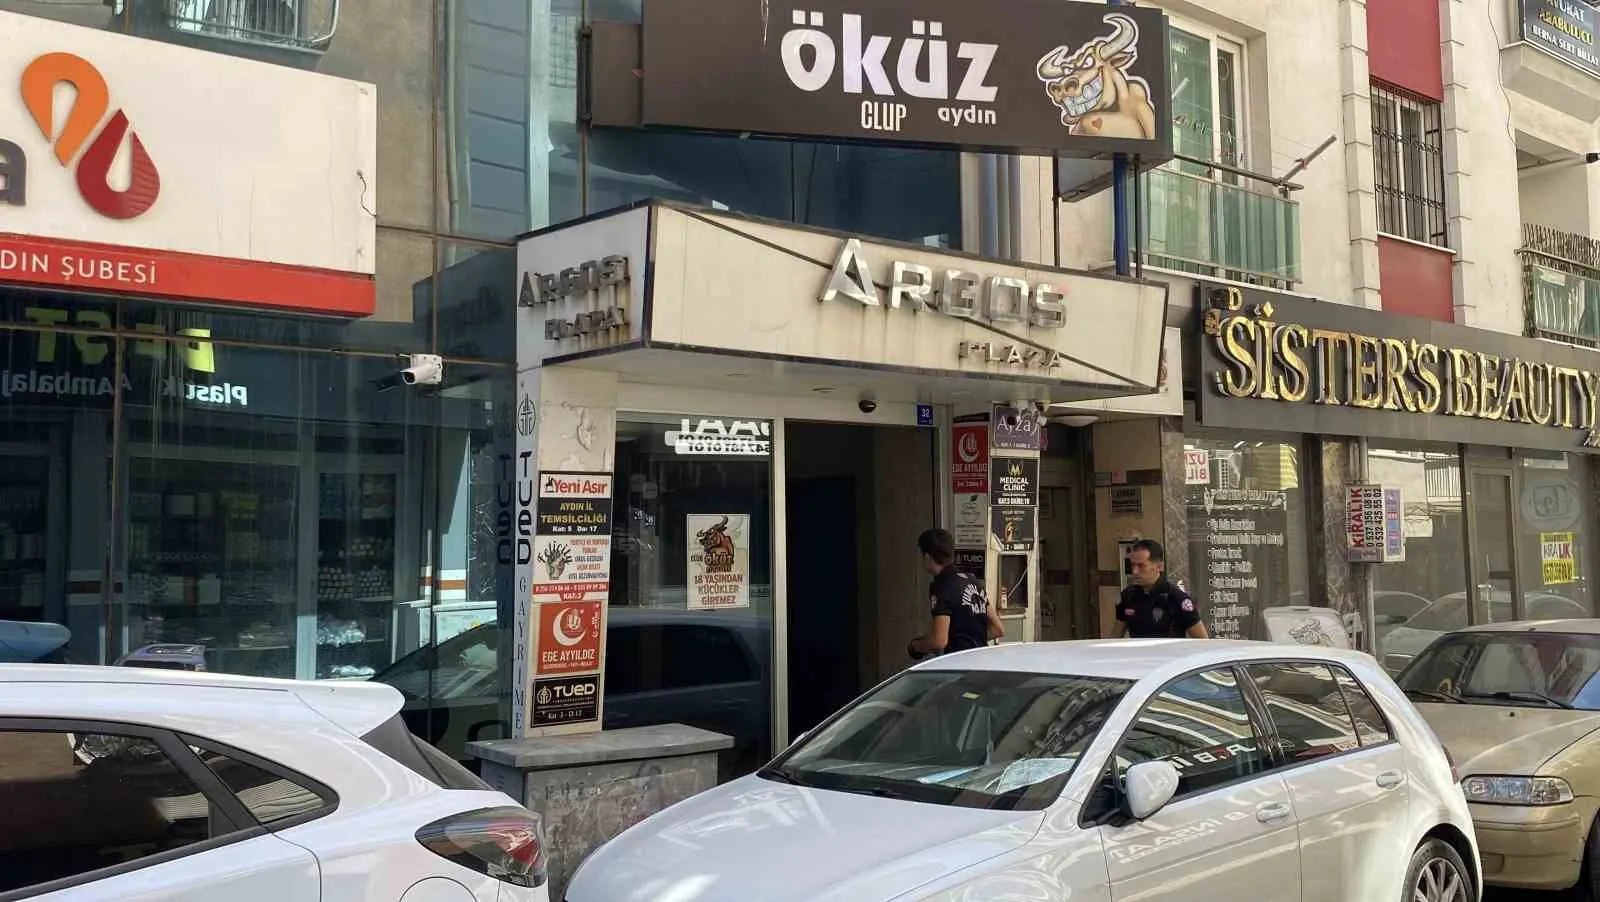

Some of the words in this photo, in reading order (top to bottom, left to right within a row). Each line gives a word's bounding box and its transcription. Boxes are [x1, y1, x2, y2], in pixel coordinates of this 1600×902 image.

[780, 9, 999, 103] öküz
[861, 100, 907, 132] CLUP
[937, 105, 997, 130] aydın
[61, 255, 157, 284] ŞUBESİ
[554, 480, 580, 494] Yeni
[542, 650, 558, 663] EGE
[560, 648, 596, 662] AYYILDIZ
